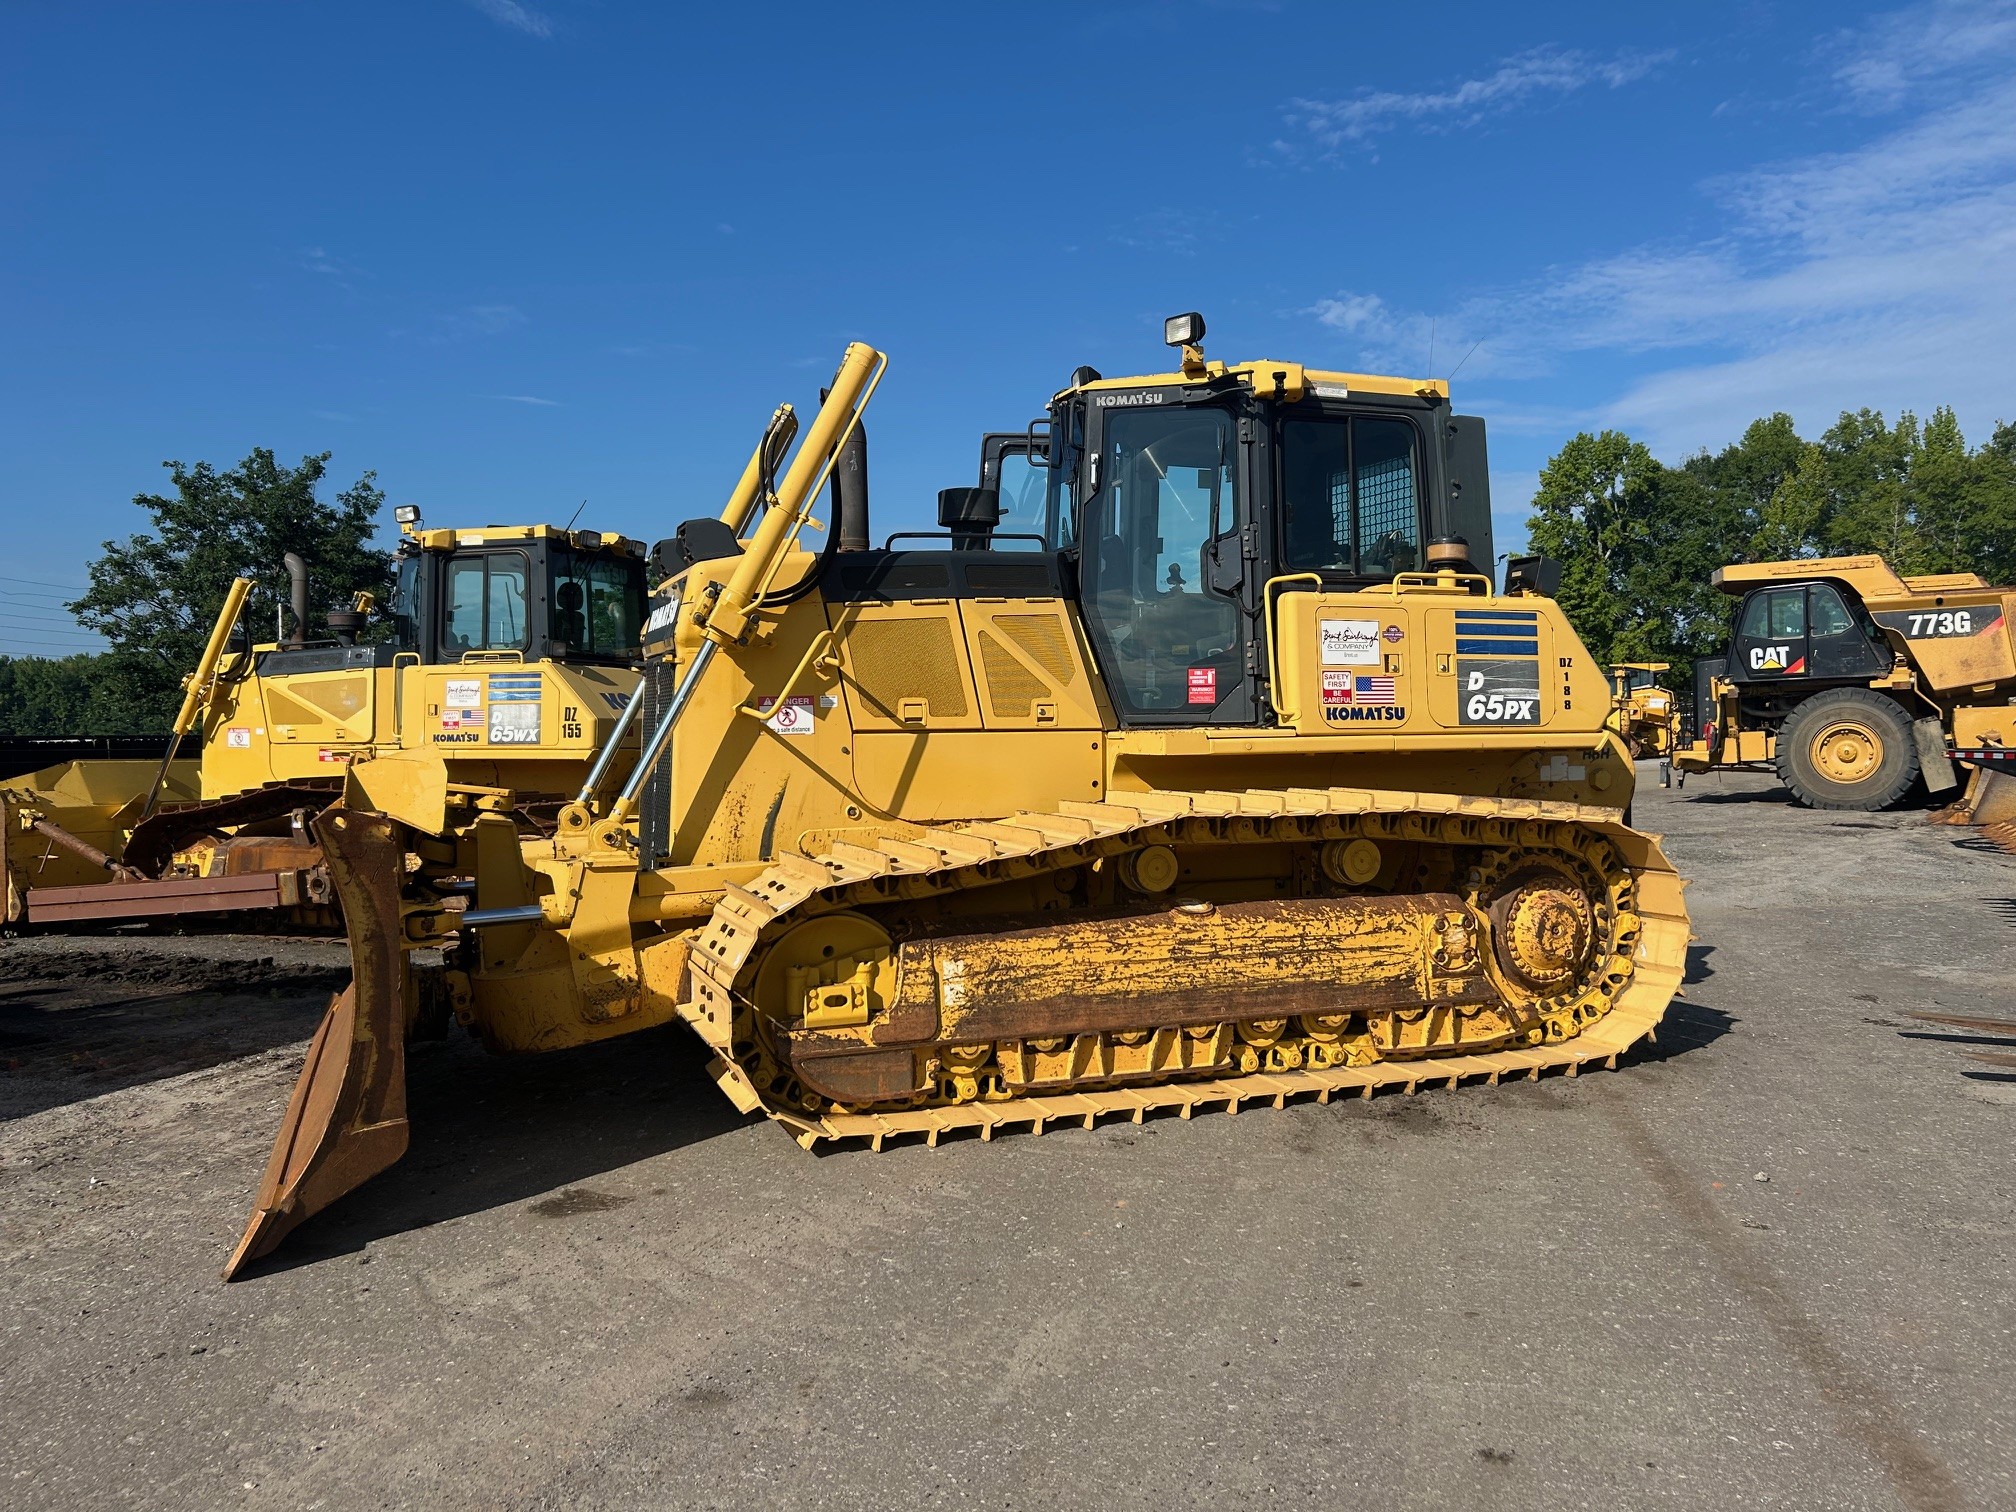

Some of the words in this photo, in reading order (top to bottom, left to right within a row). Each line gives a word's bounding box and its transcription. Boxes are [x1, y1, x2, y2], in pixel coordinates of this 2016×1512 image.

[1096, 391, 1163, 407] KOMATSU
[1908, 611, 1971, 636] 773G
[1559, 657, 1573, 668] DZ
[1750, 646, 1790, 670] CAT
[1467, 671, 1485, 691] D
[564, 707, 578, 722] DZ
[1326, 706, 1405, 720] KOMATSU
[1467, 694, 1534, 721] 65PX
[491, 712, 502, 723] D
[433, 732, 479, 742] KOMATSU
[490, 726, 540, 742] 65WX
[562, 724, 581, 738] 155
